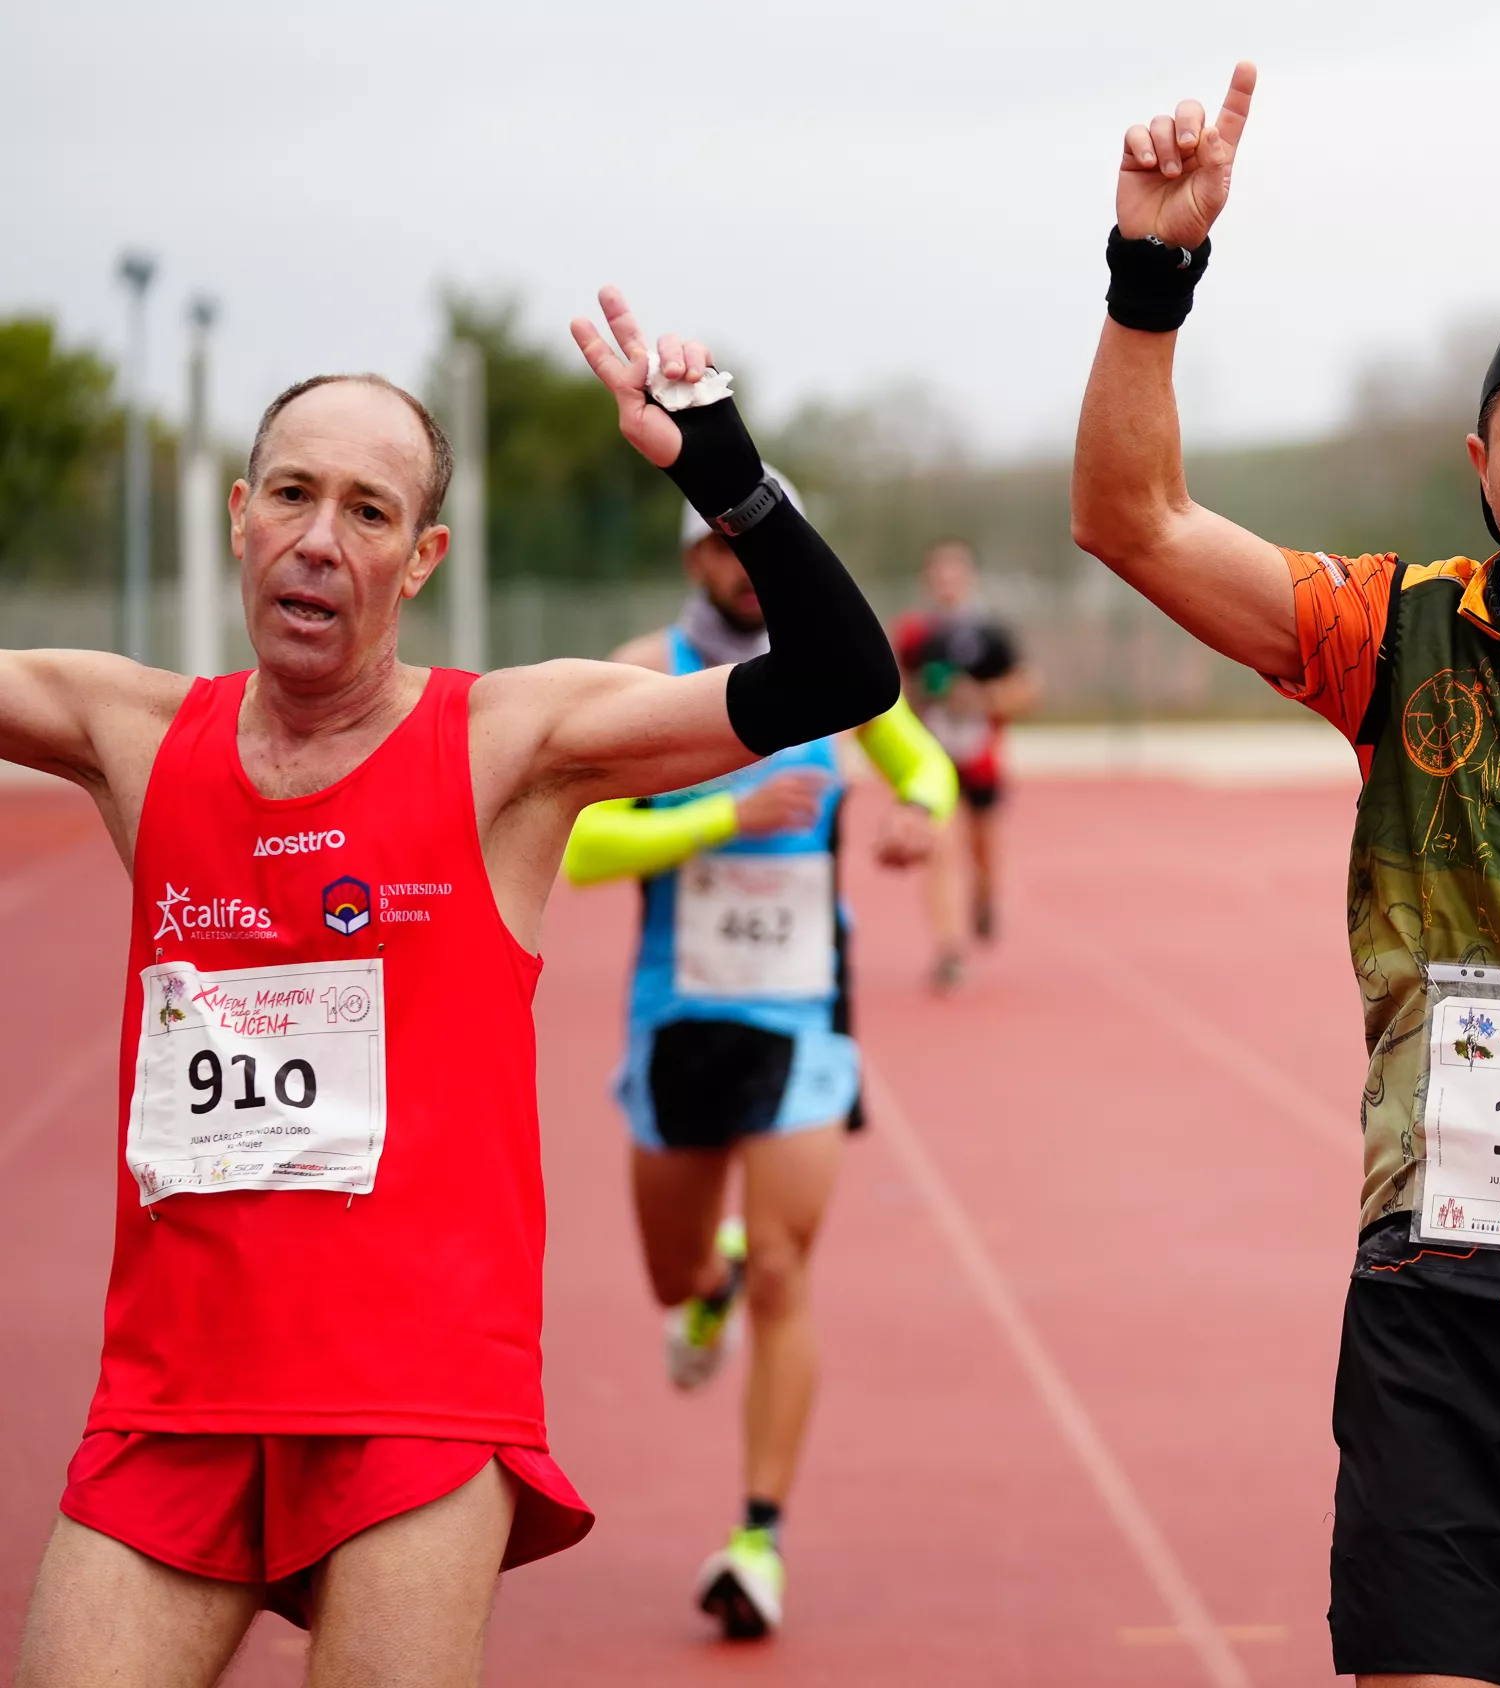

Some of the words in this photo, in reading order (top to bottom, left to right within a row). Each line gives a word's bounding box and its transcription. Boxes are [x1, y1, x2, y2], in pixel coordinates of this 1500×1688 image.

[379, 883, 452, 897] UNIVERSIDAD
[182, 898, 272, 929] califas
[379, 908, 431, 923] CÓRDOBA
[255, 988, 315, 1009] MARATÓN
[220, 1012, 300, 1036] LUCENA
[188, 1049, 317, 1114] 910
[190, 1135, 211, 1145] JUAN
[212, 1131, 243, 1143] CARLOS
[285, 1126, 311, 1135] LORO
